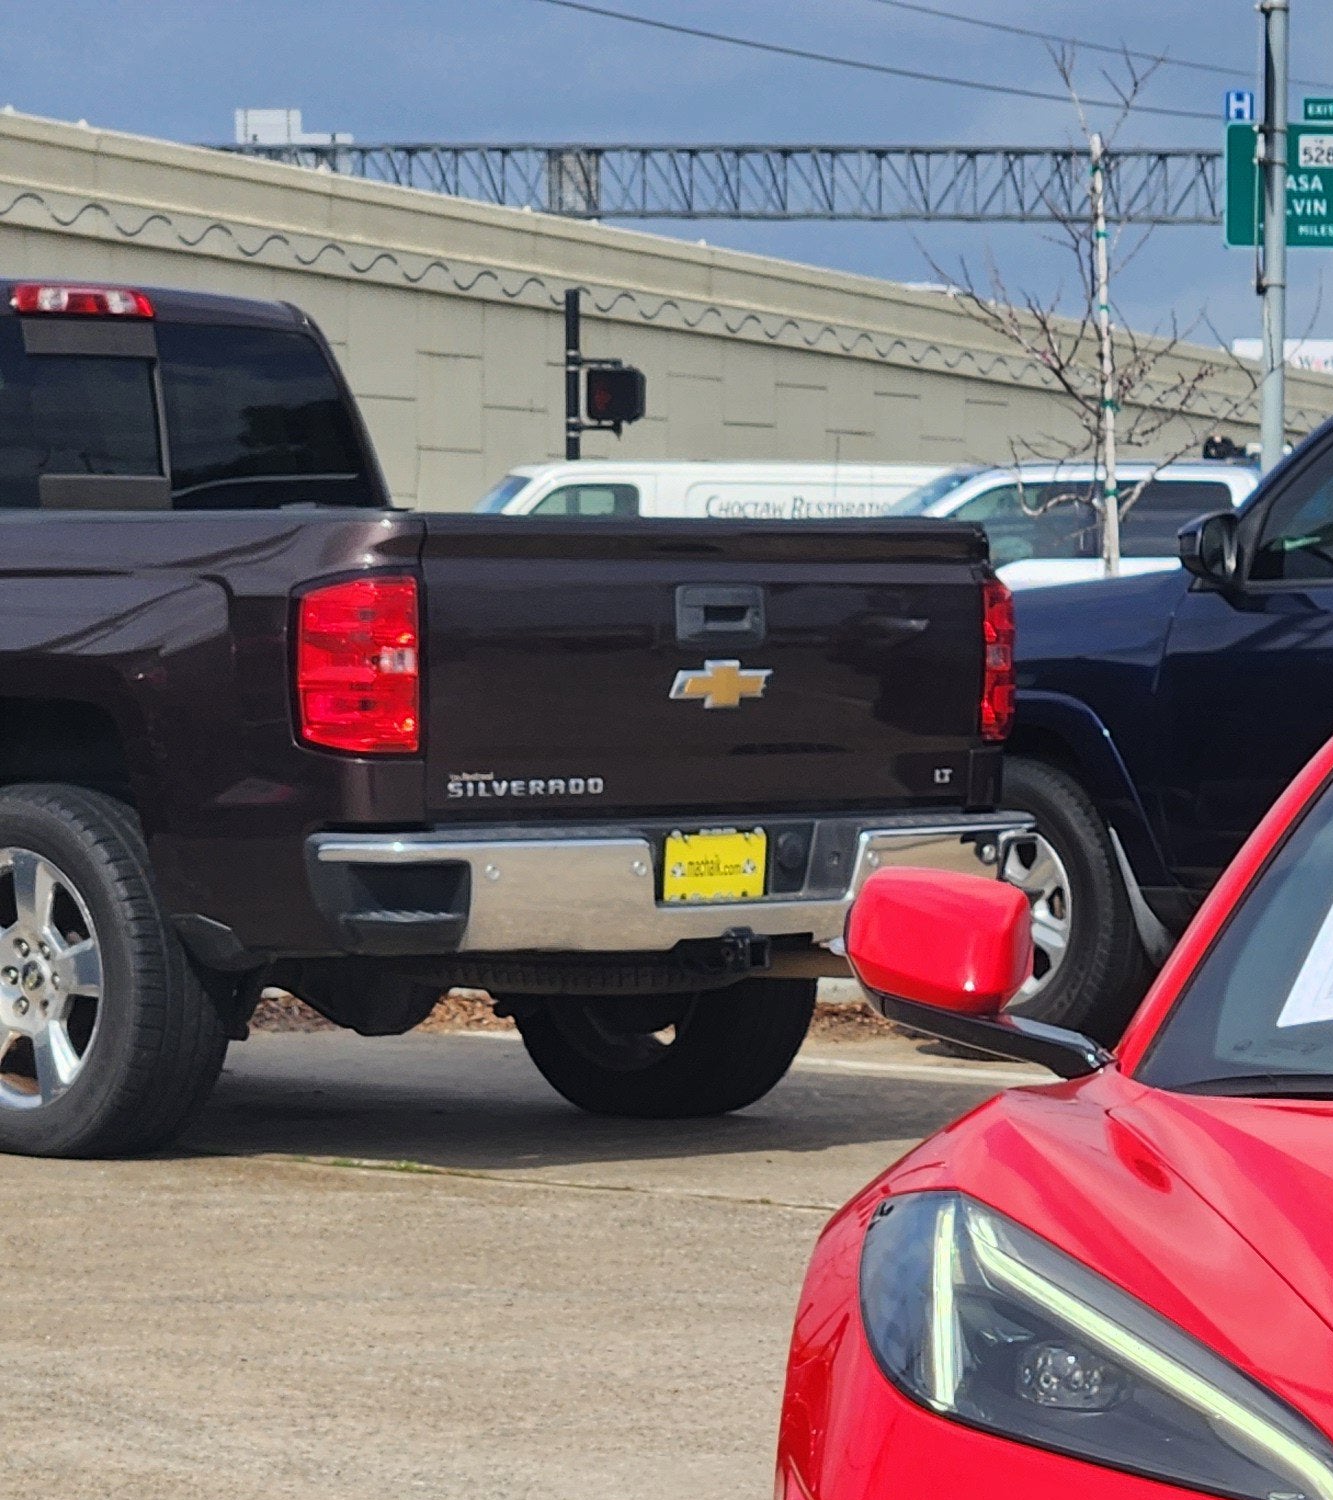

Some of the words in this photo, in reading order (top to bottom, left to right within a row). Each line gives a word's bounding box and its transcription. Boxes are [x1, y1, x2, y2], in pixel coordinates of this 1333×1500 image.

[1229, 92, 1249, 119] H
[1285, 174, 1323, 192] ASA
[1285, 198, 1327, 216] VIN
[934, 768, 953, 784] LT
[447, 777, 604, 798] SILVERADO
